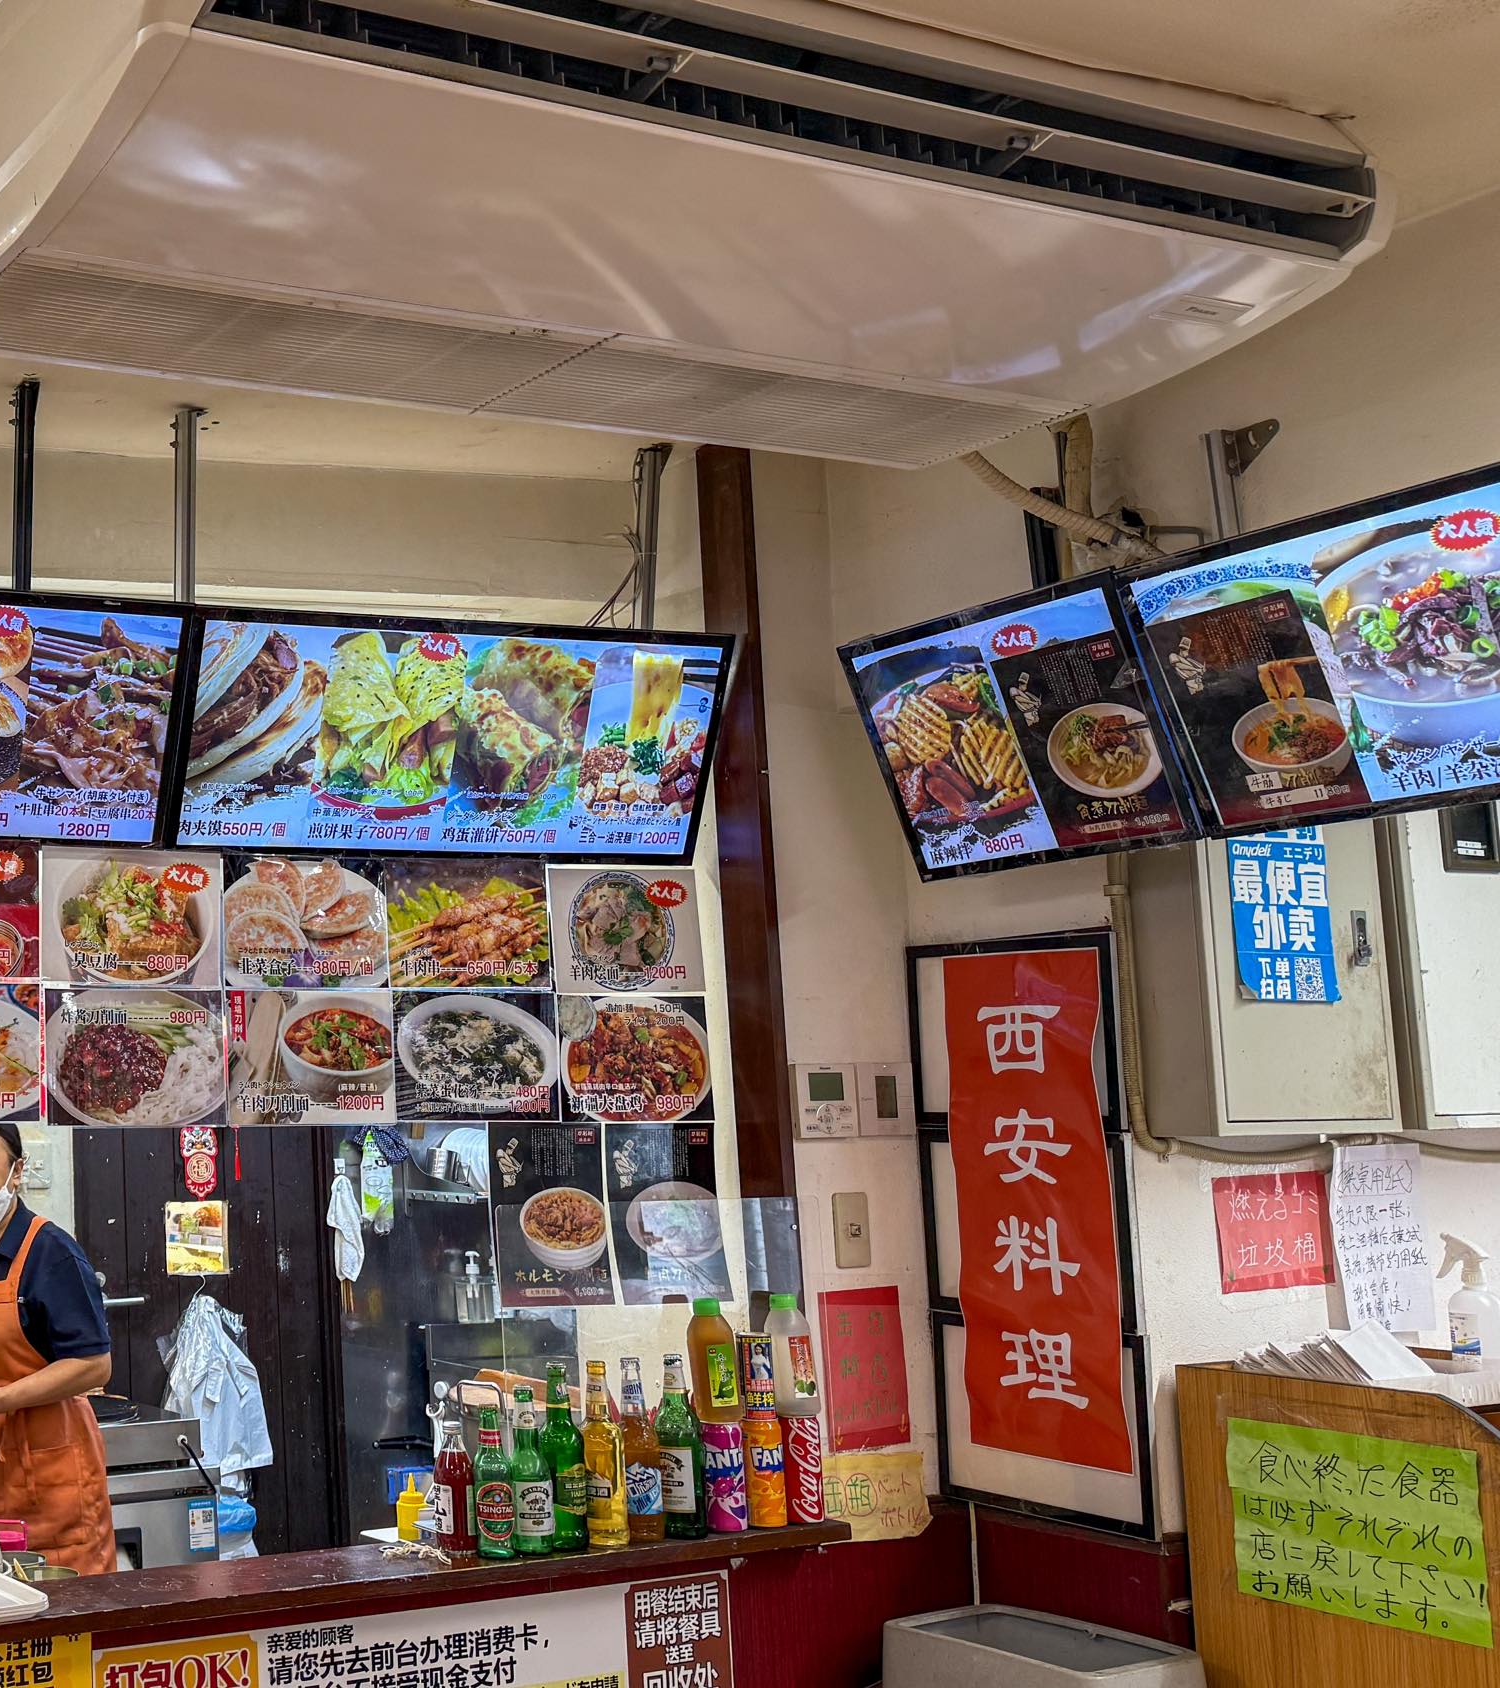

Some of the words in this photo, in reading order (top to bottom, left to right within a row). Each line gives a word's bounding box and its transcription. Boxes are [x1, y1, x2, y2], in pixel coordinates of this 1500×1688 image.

[57, 821, 111, 838] 1280円
[637, 831, 681, 845] 1200円
[930, 843, 973, 864] 麻辣拌
[984, 832, 1025, 853] 880円
[1232, 859, 1328, 907] 最便宜
[1252, 905, 1316, 952] 外卖
[72, 952, 119, 971] 臭豆腐
[146, 955, 189, 971] 880円
[313, 960, 375, 977] 380円/個
[400, 959, 441, 977] 牛肉串
[467, 960, 539, 977] 650円/5本
[1257, 956, 1290, 979] 下单
[644, 965, 687, 981] 1200円
[1260, 978, 1292, 1000] 扫码
[169, 1010, 207, 1025] 980円
[652, 1003, 682, 1014] 150円
[655, 1015, 685, 1027] 200円
[514, 1084, 550, 1099] 480円
[236, 1094, 310, 1114] 羊肉刀削面
[336, 1095, 385, 1112] 1200円
[508, 1099, 551, 1114] 1200円
[655, 1095, 697, 1111] 980円
[977, 1004, 1089, 1410] 西安料理
[1228, 1186, 1320, 1225] 燃えるゴミ
[1237, 1232, 1317, 1270] 垃圾桶
[705, 1448, 743, 1469] ANT
[751, 1445, 784, 1468] FAN
[479, 1503, 513, 1514] TSINGTAO
[1243, 1493, 1472, 1560] は必ずそれぞれの
[633, 1581, 720, 1619] 用餐结束后
[1252, 1570, 1449, 1630] お願いします。
[266, 1624, 354, 1653] 亲爱的顾客
[664, 1644, 695, 1665] 送至
